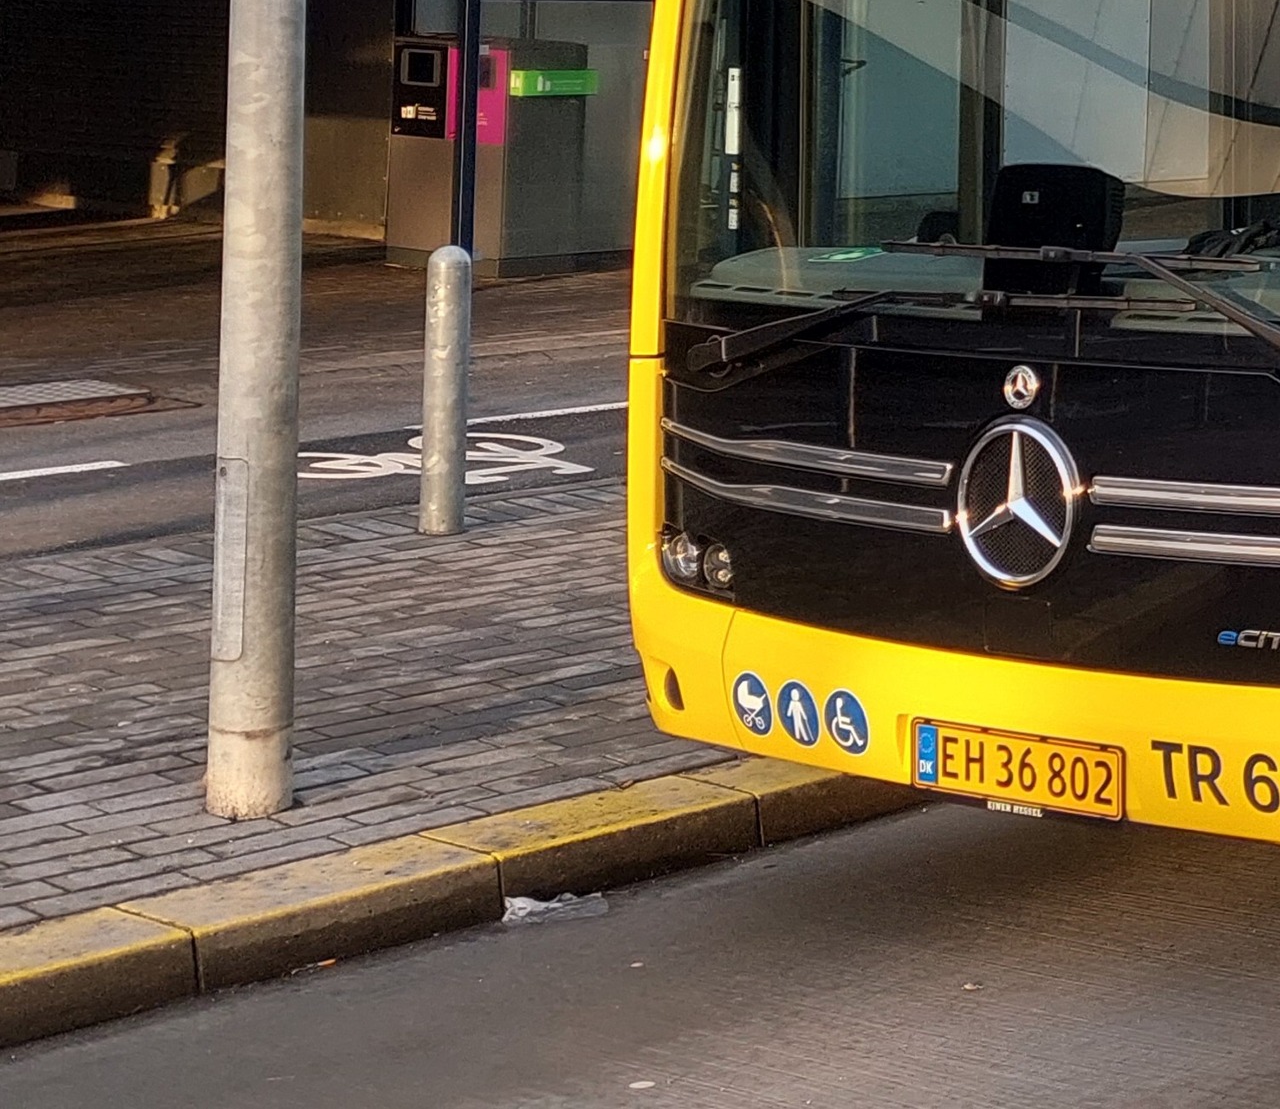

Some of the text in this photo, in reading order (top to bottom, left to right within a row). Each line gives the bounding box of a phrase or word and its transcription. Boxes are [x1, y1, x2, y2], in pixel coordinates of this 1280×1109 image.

[918, 759, 934, 776] DK
[941, 736, 1113, 806] EH 36 802
[1151, 741, 1230, 807] TR
